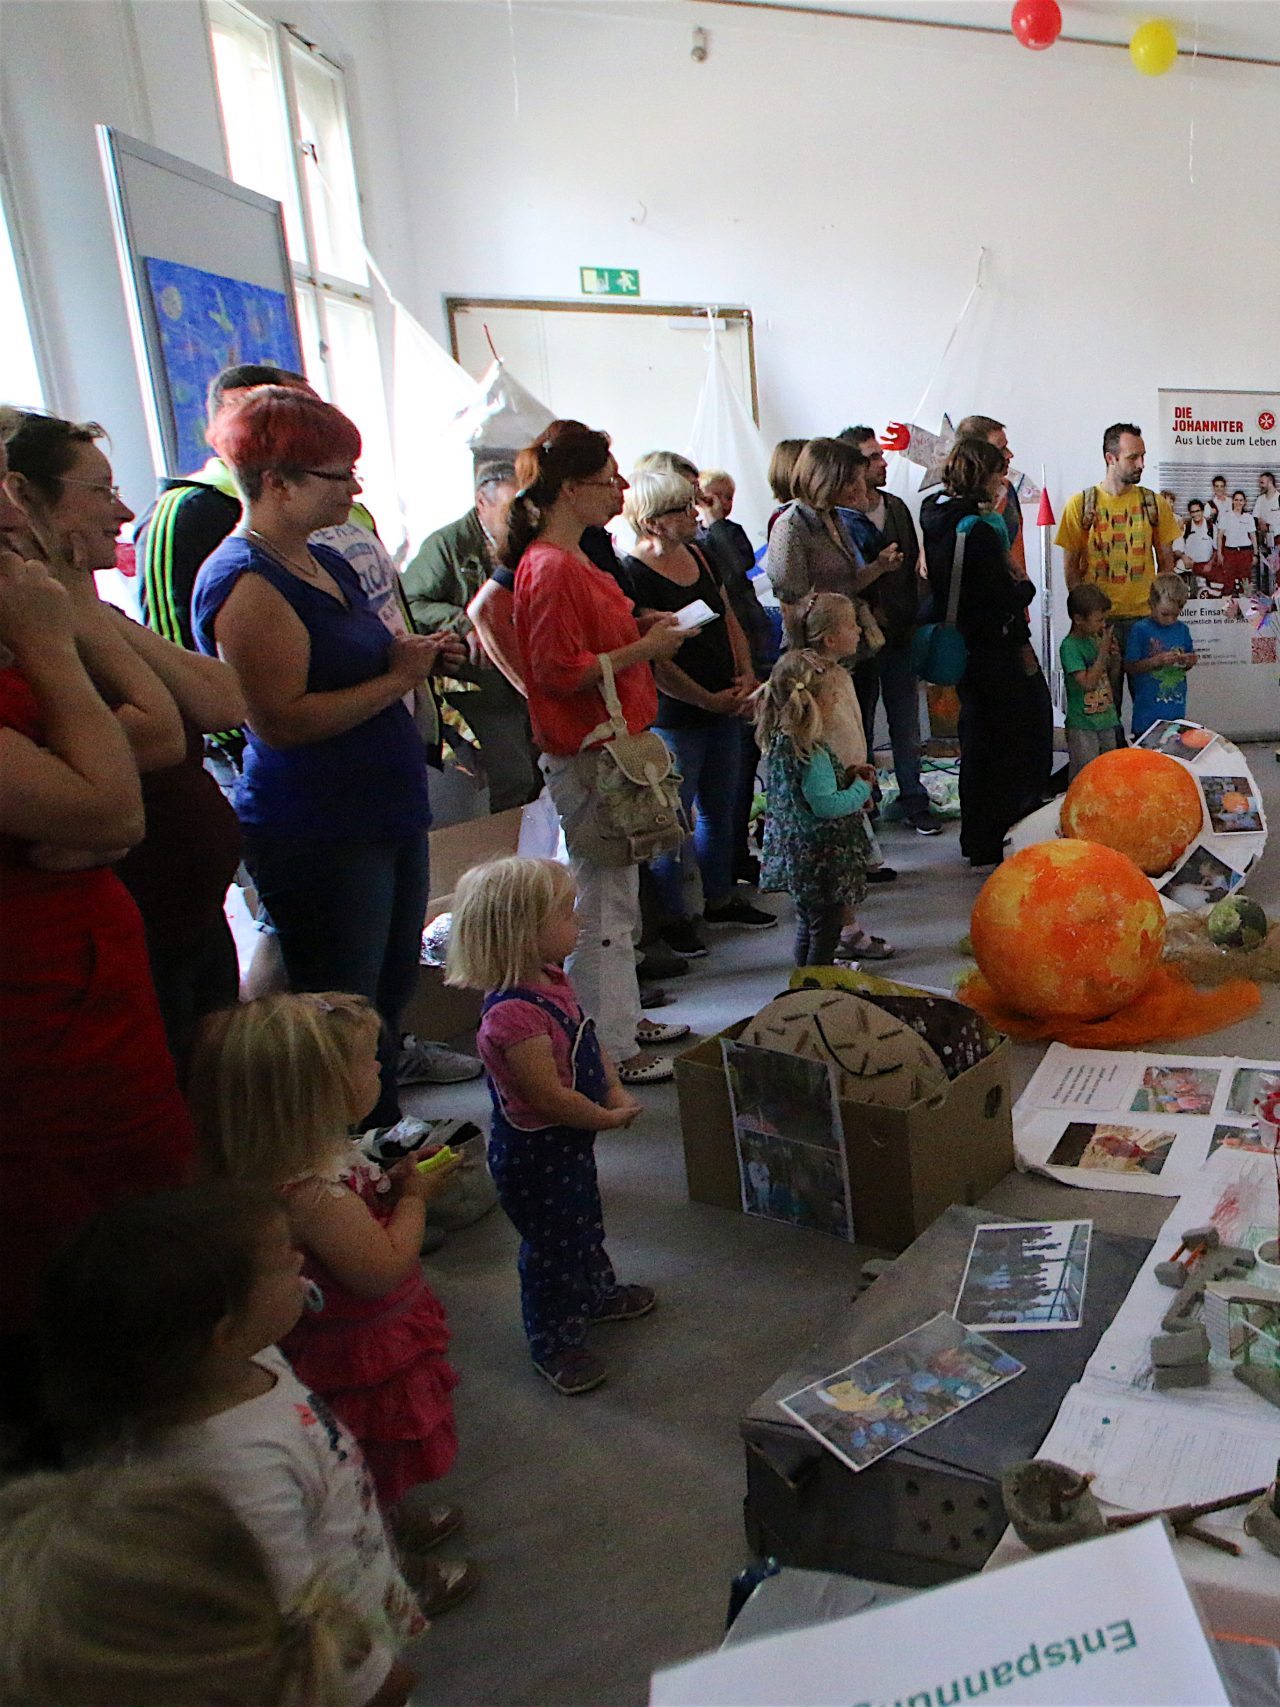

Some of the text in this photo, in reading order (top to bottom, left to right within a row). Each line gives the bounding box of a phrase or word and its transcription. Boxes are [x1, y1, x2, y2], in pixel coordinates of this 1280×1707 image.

[1174, 407, 1192, 419] DIE
[1172, 419, 1244, 433] JOHANNITER
[1174, 434, 1277, 447] Aus Liebe zum Leben
[1179, 607, 1225, 617] oller Einsat
[850, 1619, 1138, 1707] Entspannu
